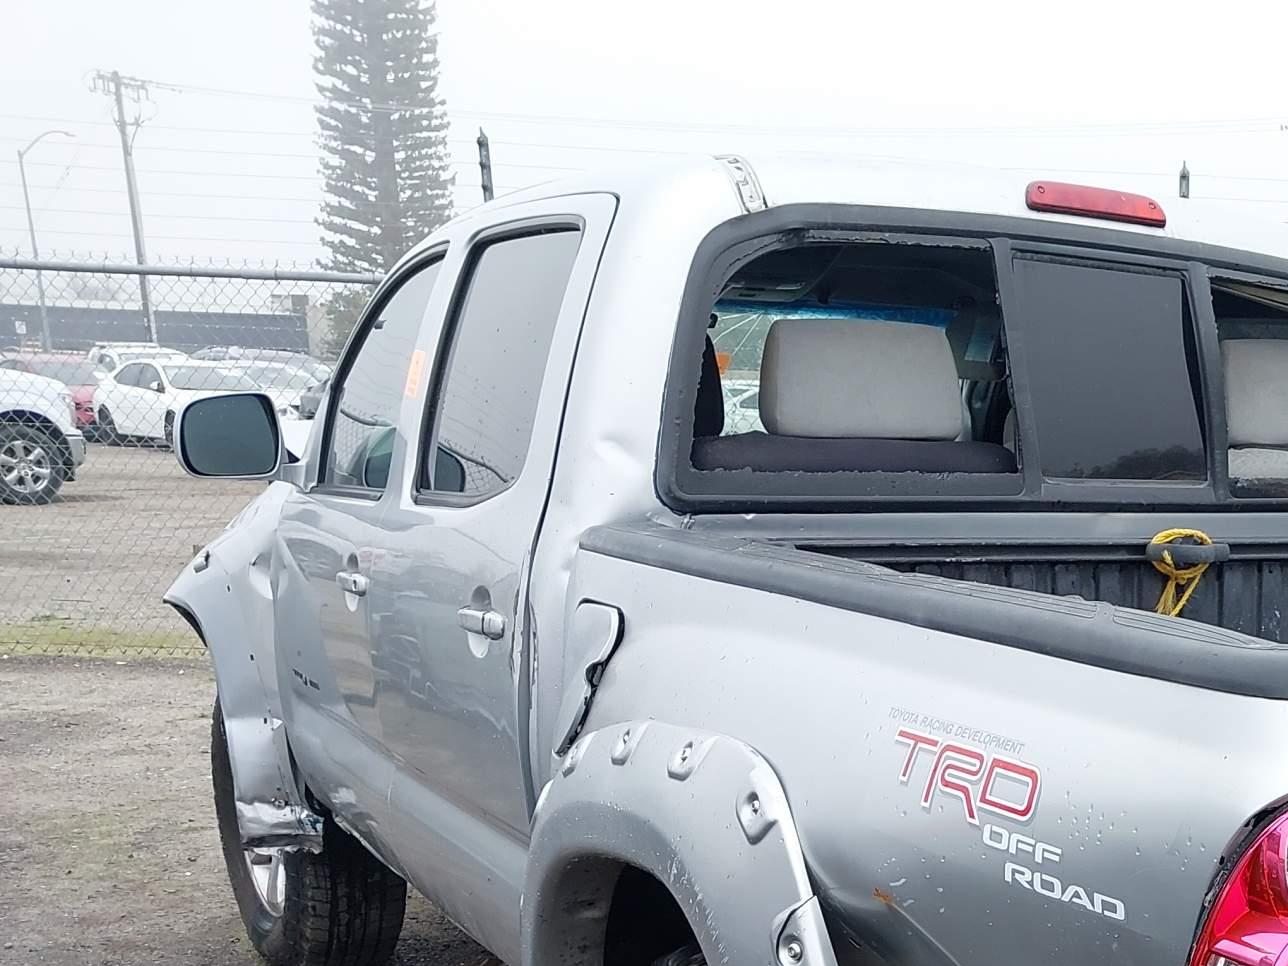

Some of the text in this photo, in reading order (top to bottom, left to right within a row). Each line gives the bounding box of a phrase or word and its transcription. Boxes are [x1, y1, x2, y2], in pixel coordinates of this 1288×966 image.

[888, 707, 1025, 755] TOYOTA RACING DEVELOPMENT
[895, 727, 1041, 825] TRD
[983, 823, 1062, 864] OFF
[1004, 862, 1126, 920] ROAD
